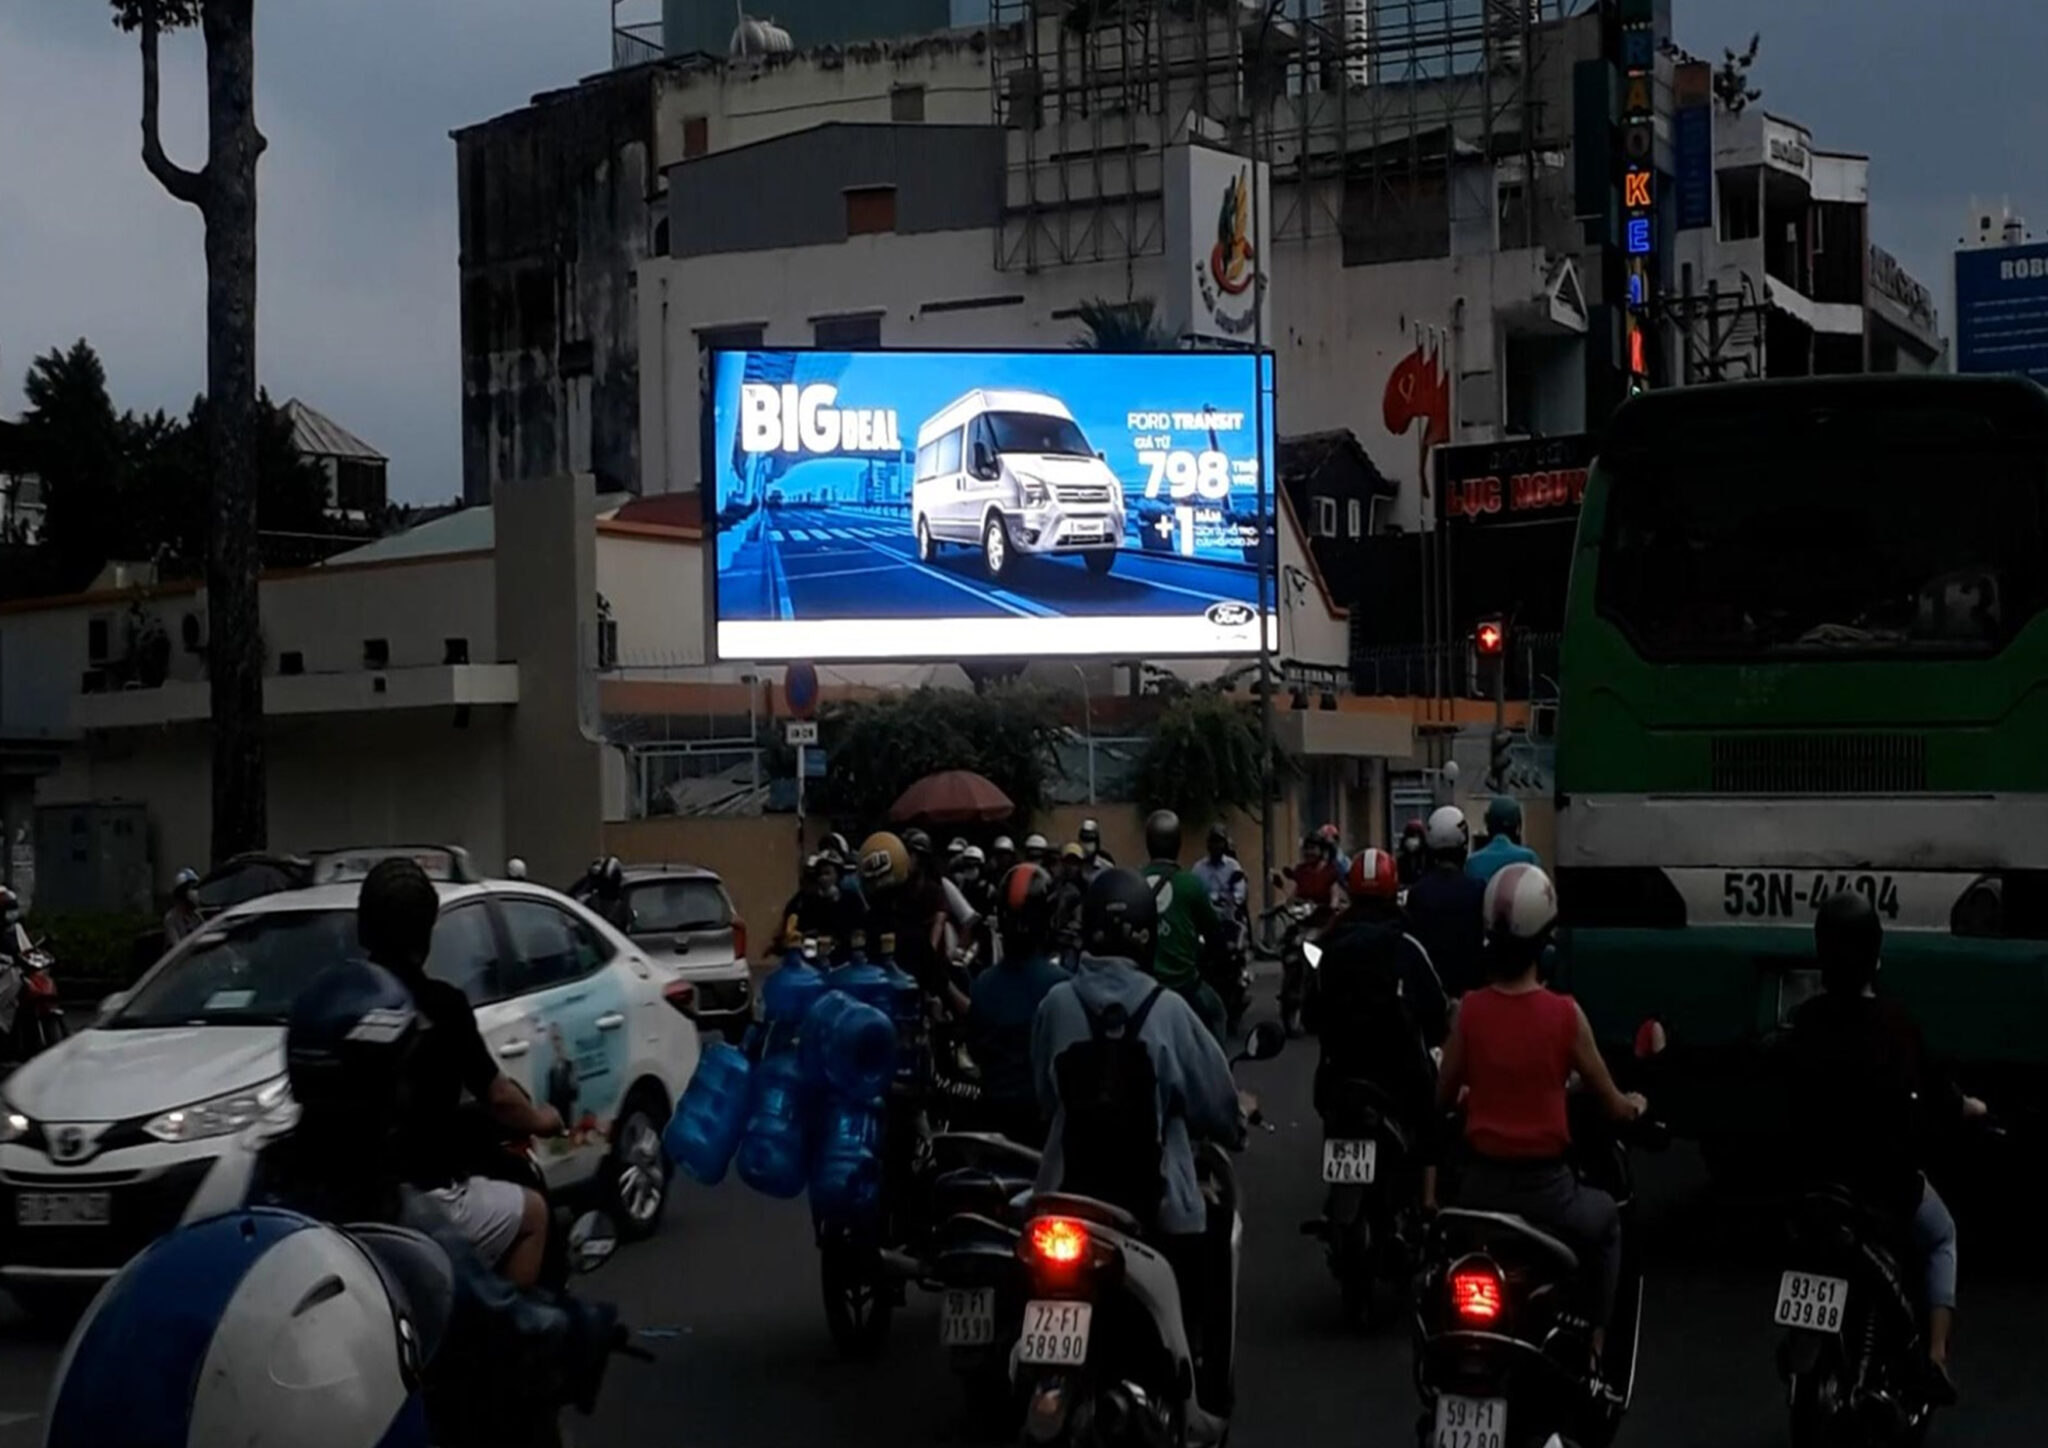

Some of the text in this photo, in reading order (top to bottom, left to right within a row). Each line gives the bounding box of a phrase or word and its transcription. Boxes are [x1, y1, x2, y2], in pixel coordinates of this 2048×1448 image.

[2000, 257, 2048, 280] ROB
[741, 384, 902, 453] BIG DEAL
[1127, 412, 1244, 430] FORD TRANSIT
[1138, 451, 1229, 499] 798
